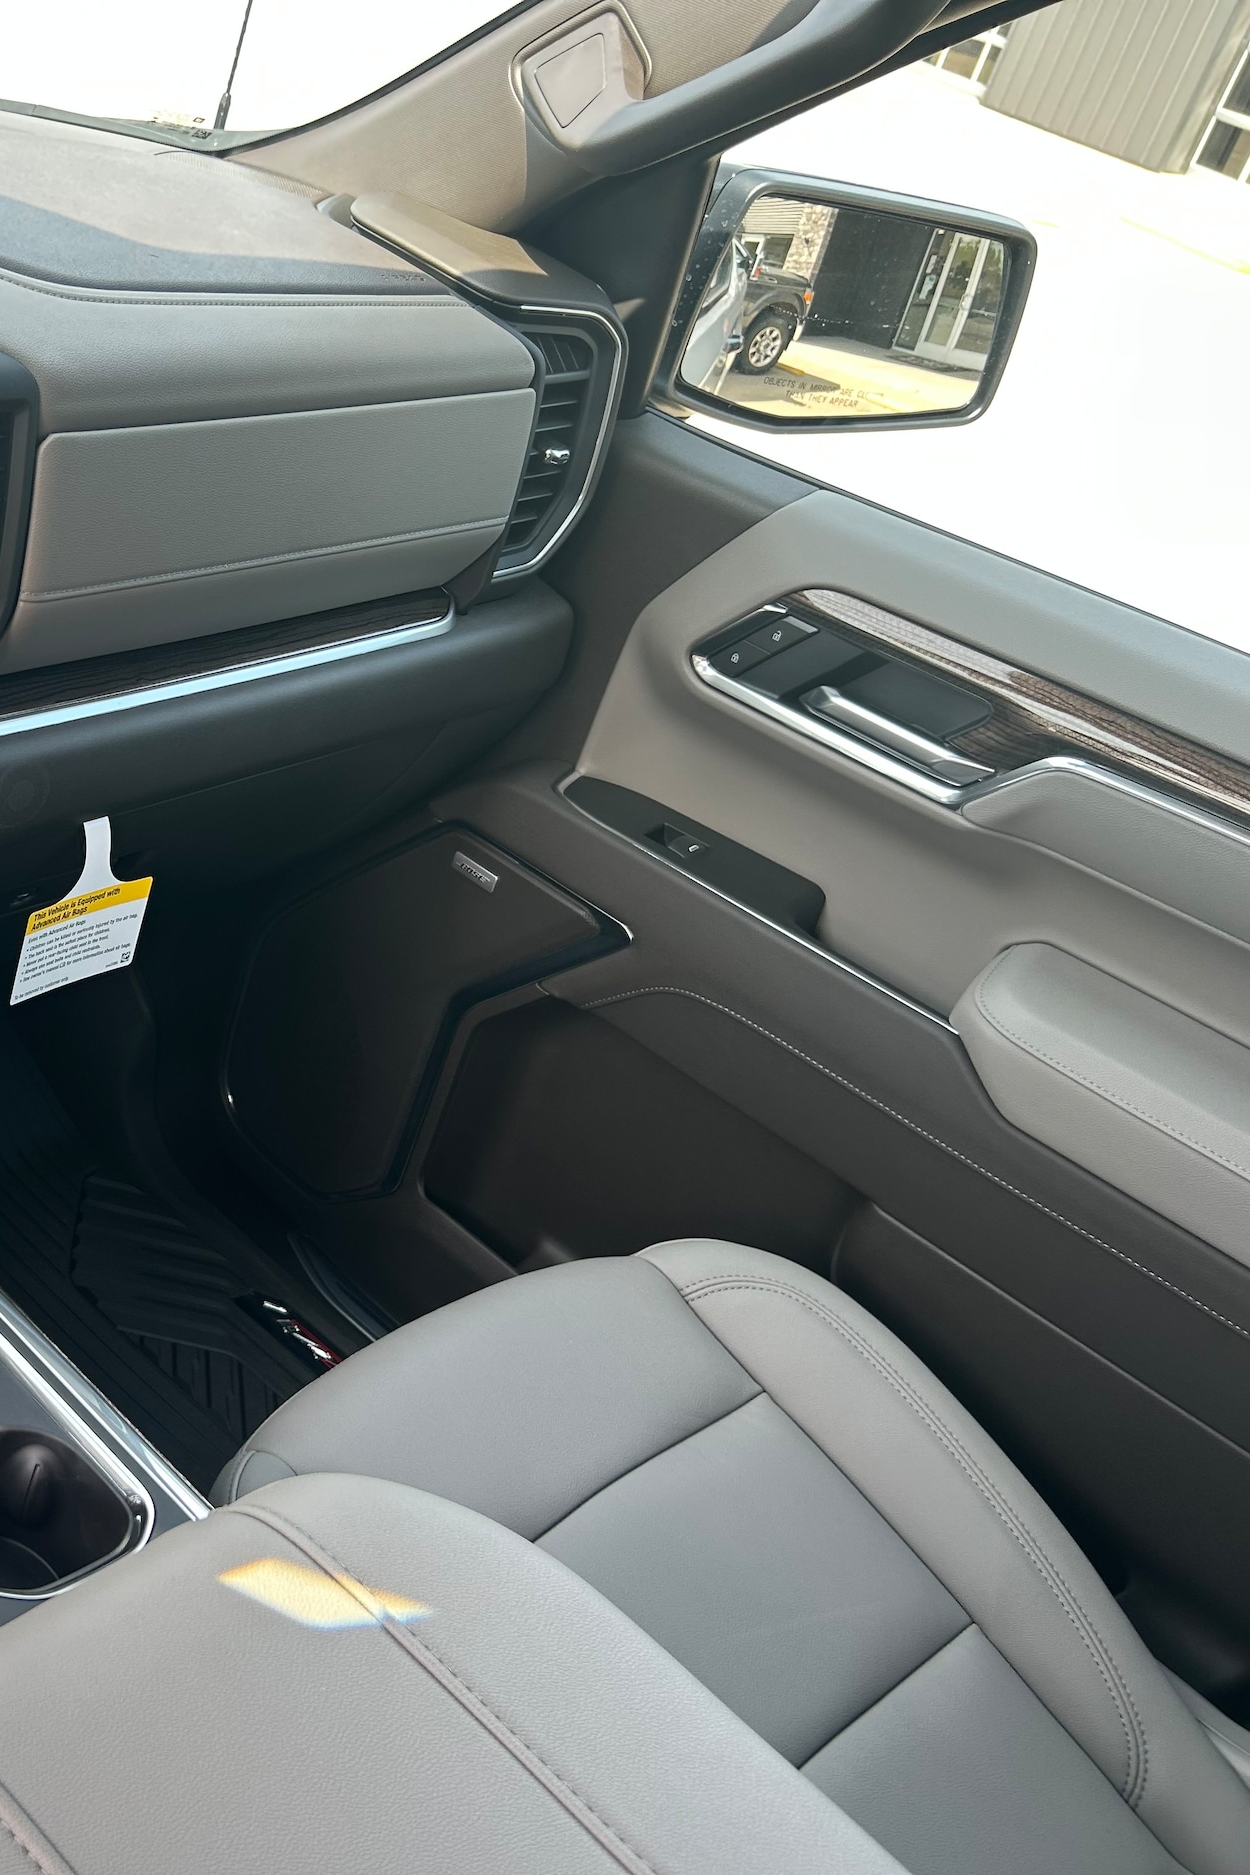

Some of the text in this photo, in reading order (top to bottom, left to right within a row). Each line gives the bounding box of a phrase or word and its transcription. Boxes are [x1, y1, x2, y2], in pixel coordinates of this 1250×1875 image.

[764, 376, 796, 388] OBJECTS
[798, 383, 807, 391] IN
[810, 383, 838, 393] MIRROR
[839, 388, 854, 397] ARE
[785, 390, 858, 408] THAN THEY APPEAR
[34, 912, 46, 922] This
[48, 904, 69, 916] Vehicle
[77, 892, 106, 906] Equipped
[106, 888, 120, 896] with
[31, 906, 88, 931] Advanced Air Bags
